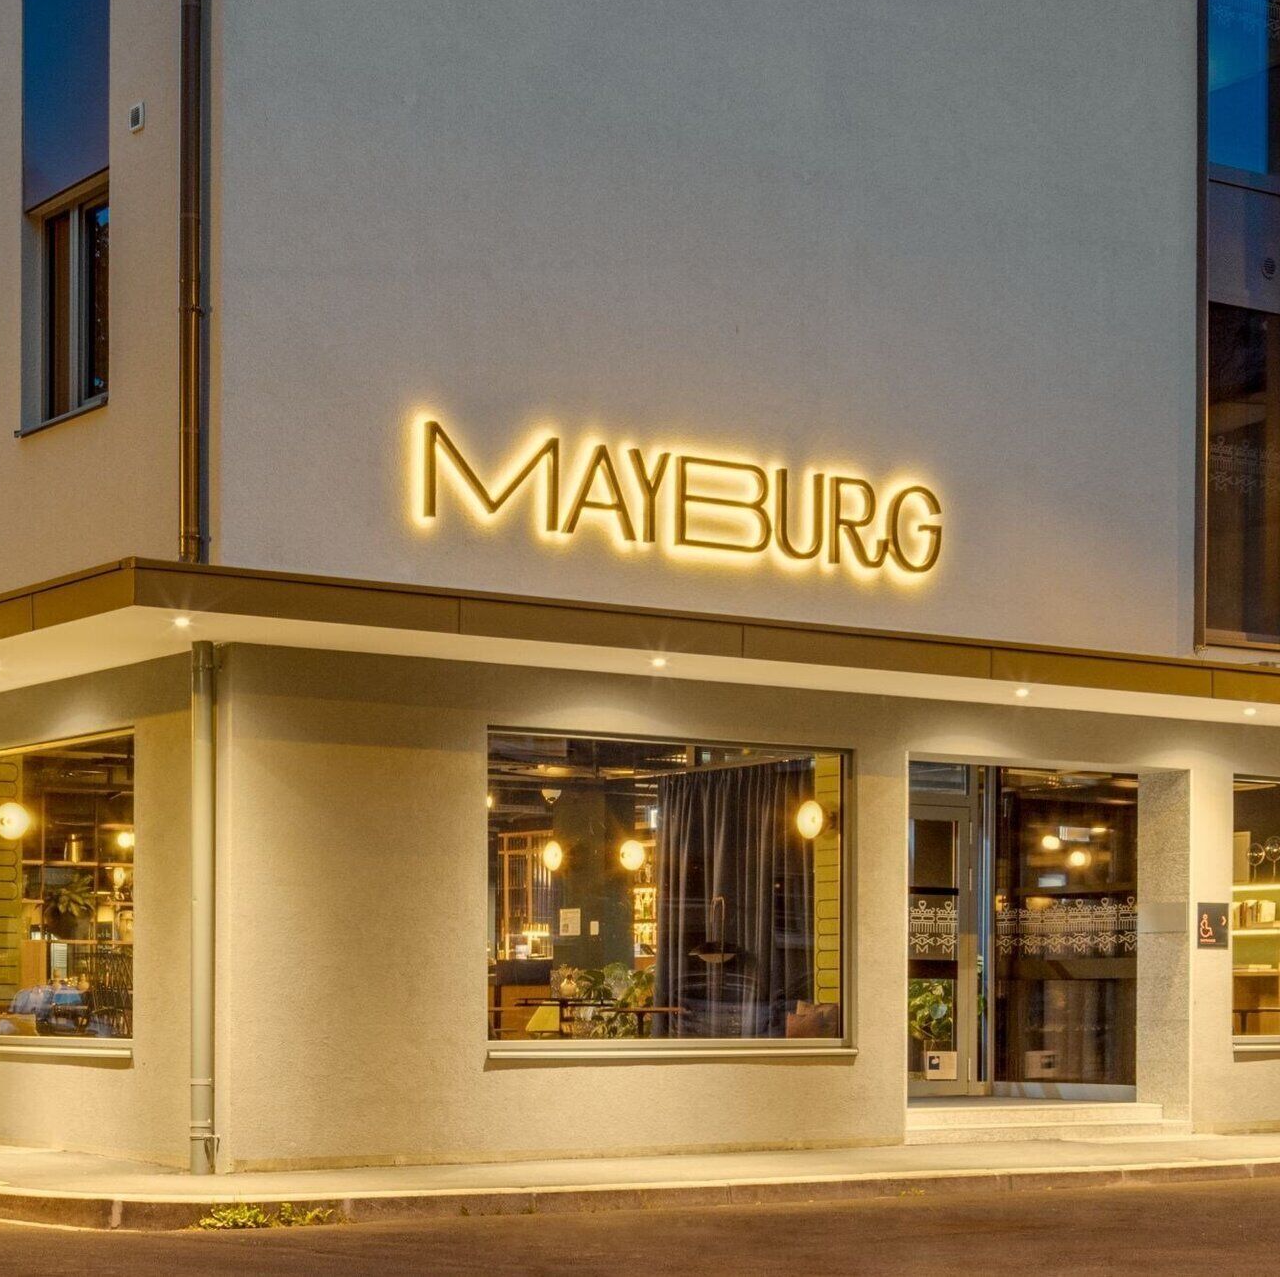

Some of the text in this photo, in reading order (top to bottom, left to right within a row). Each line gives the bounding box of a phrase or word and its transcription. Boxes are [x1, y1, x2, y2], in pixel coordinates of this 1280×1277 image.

[422, 419, 944, 574] MAYBURG
[915, 944, 955, 954] M M
